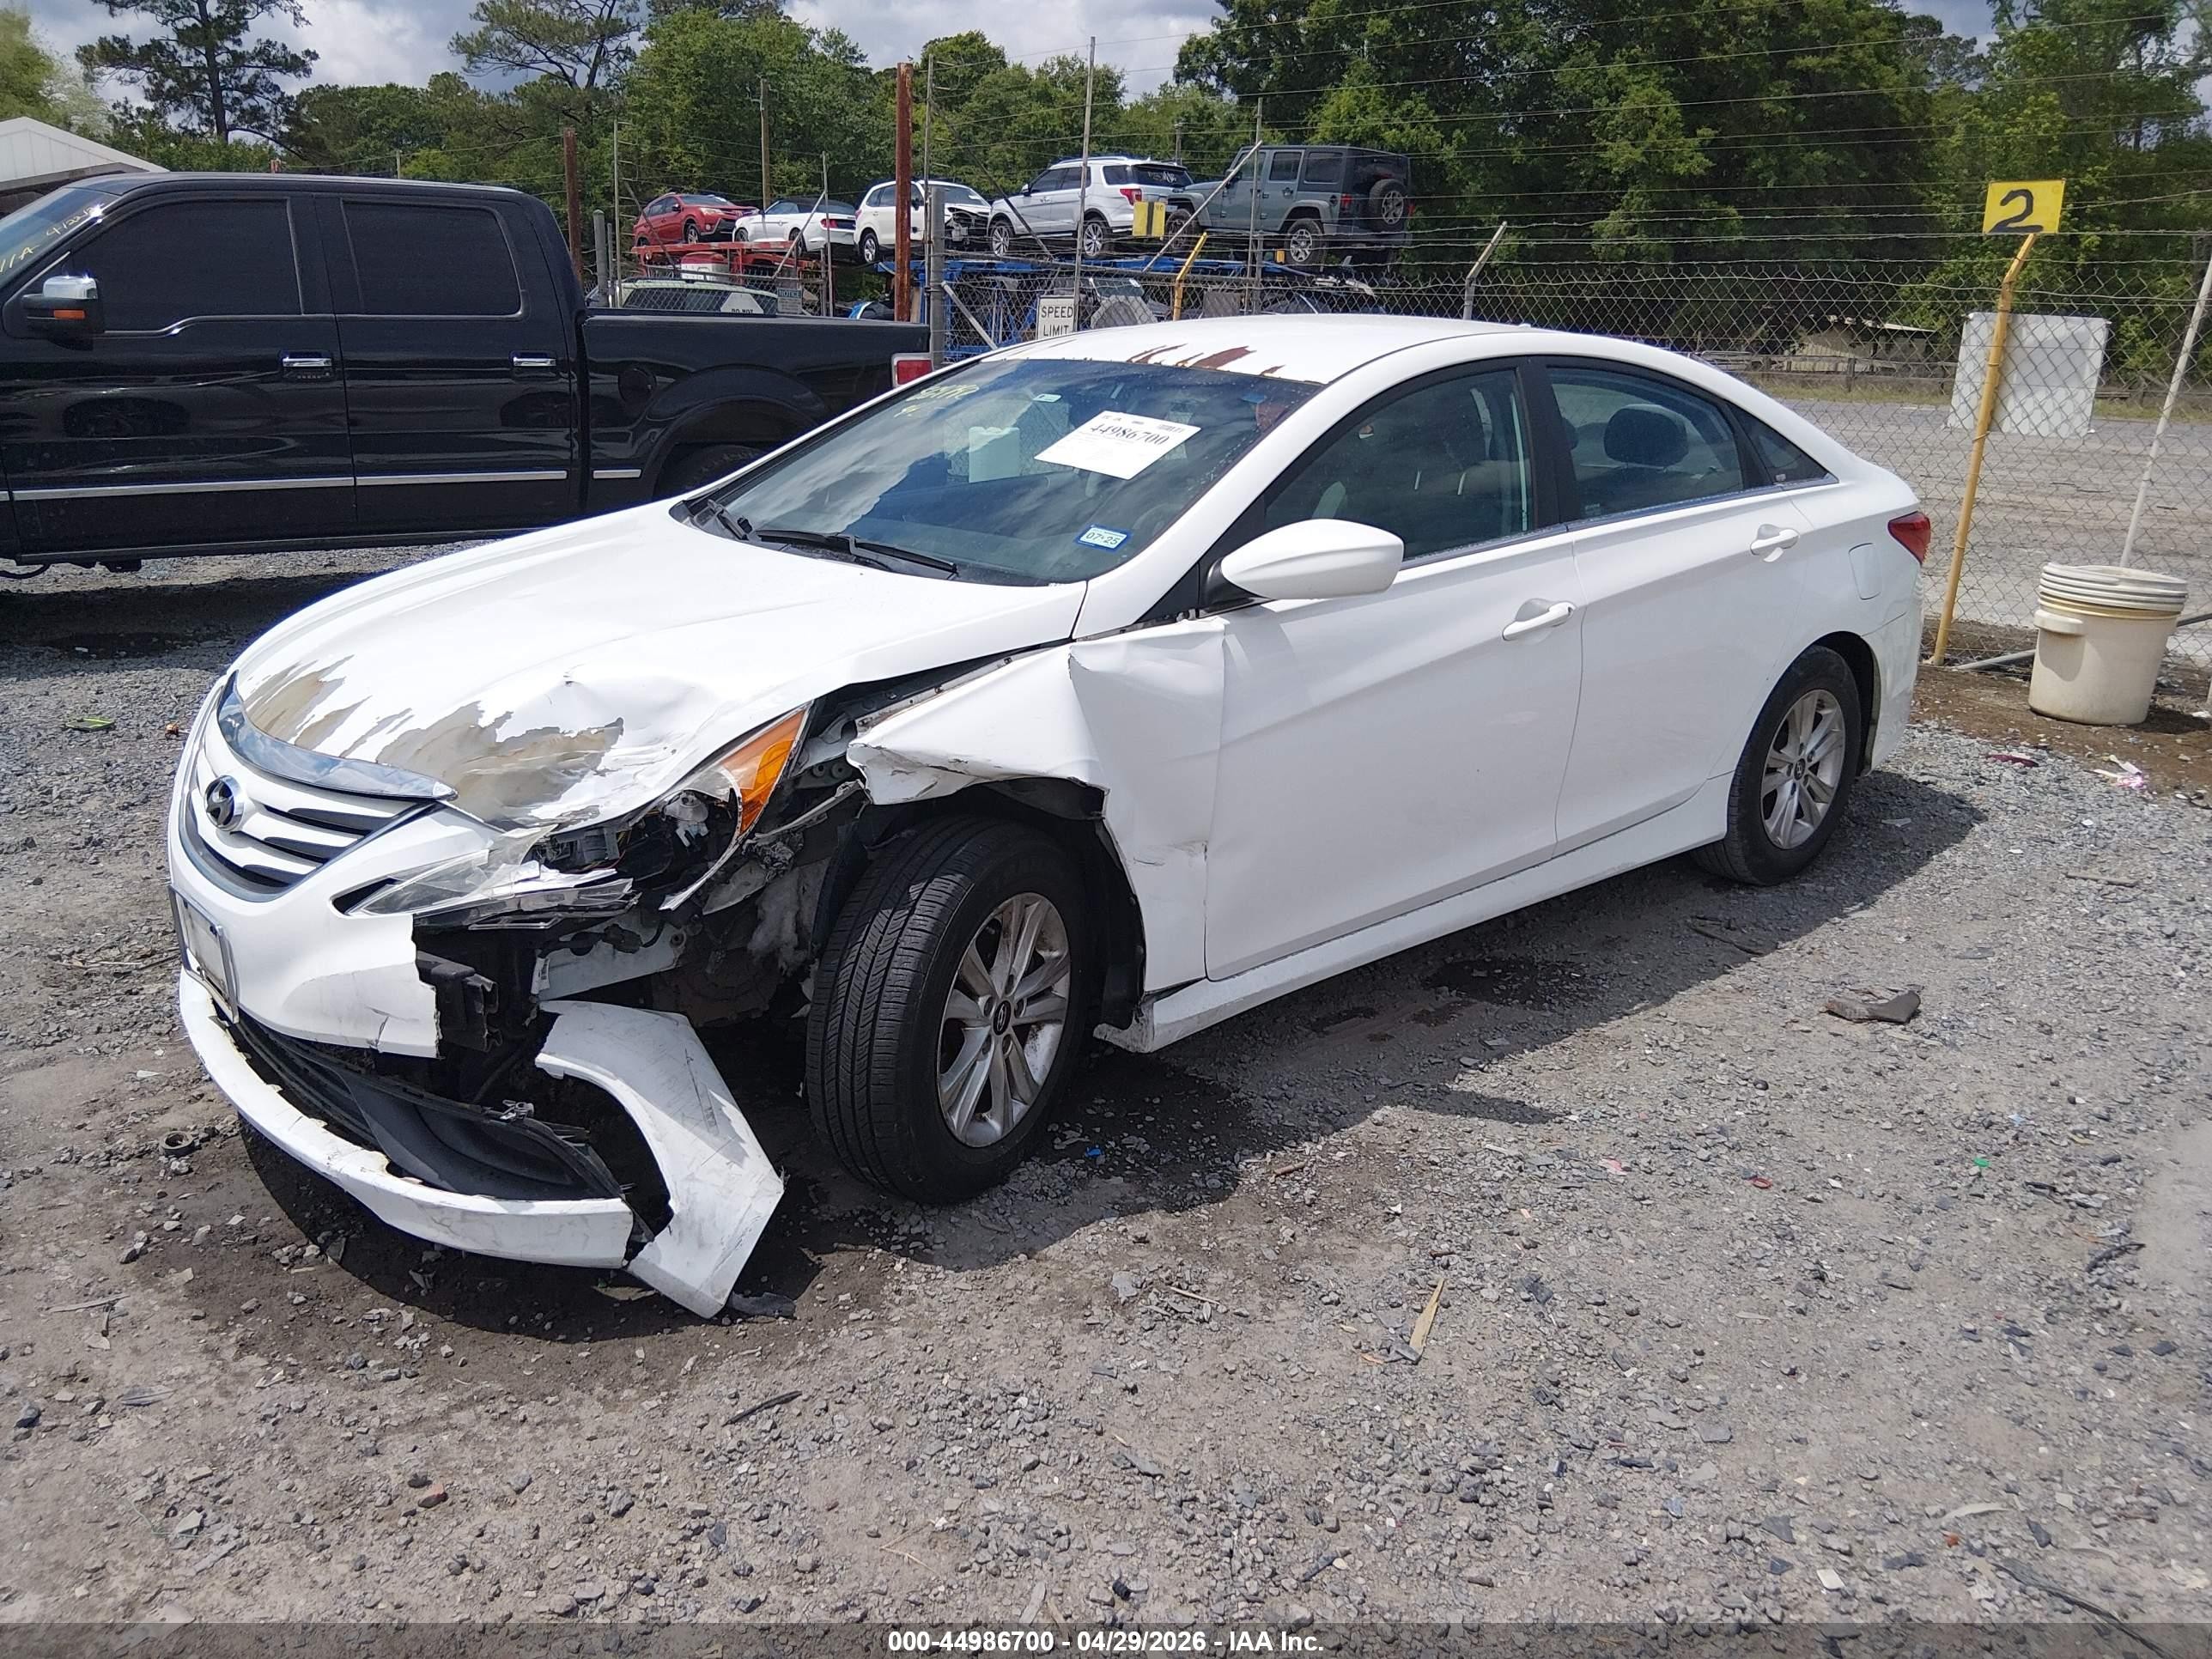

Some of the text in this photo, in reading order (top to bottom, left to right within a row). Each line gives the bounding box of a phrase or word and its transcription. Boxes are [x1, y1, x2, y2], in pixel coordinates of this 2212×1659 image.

[1987, 189, 2045, 234] 2
[778, 289, 801, 298] NOTICE
[1041, 306, 1073, 319] SPEED
[1043, 324, 1070, 337] LIMIT
[1091, 423, 1170, 446] 44986700
